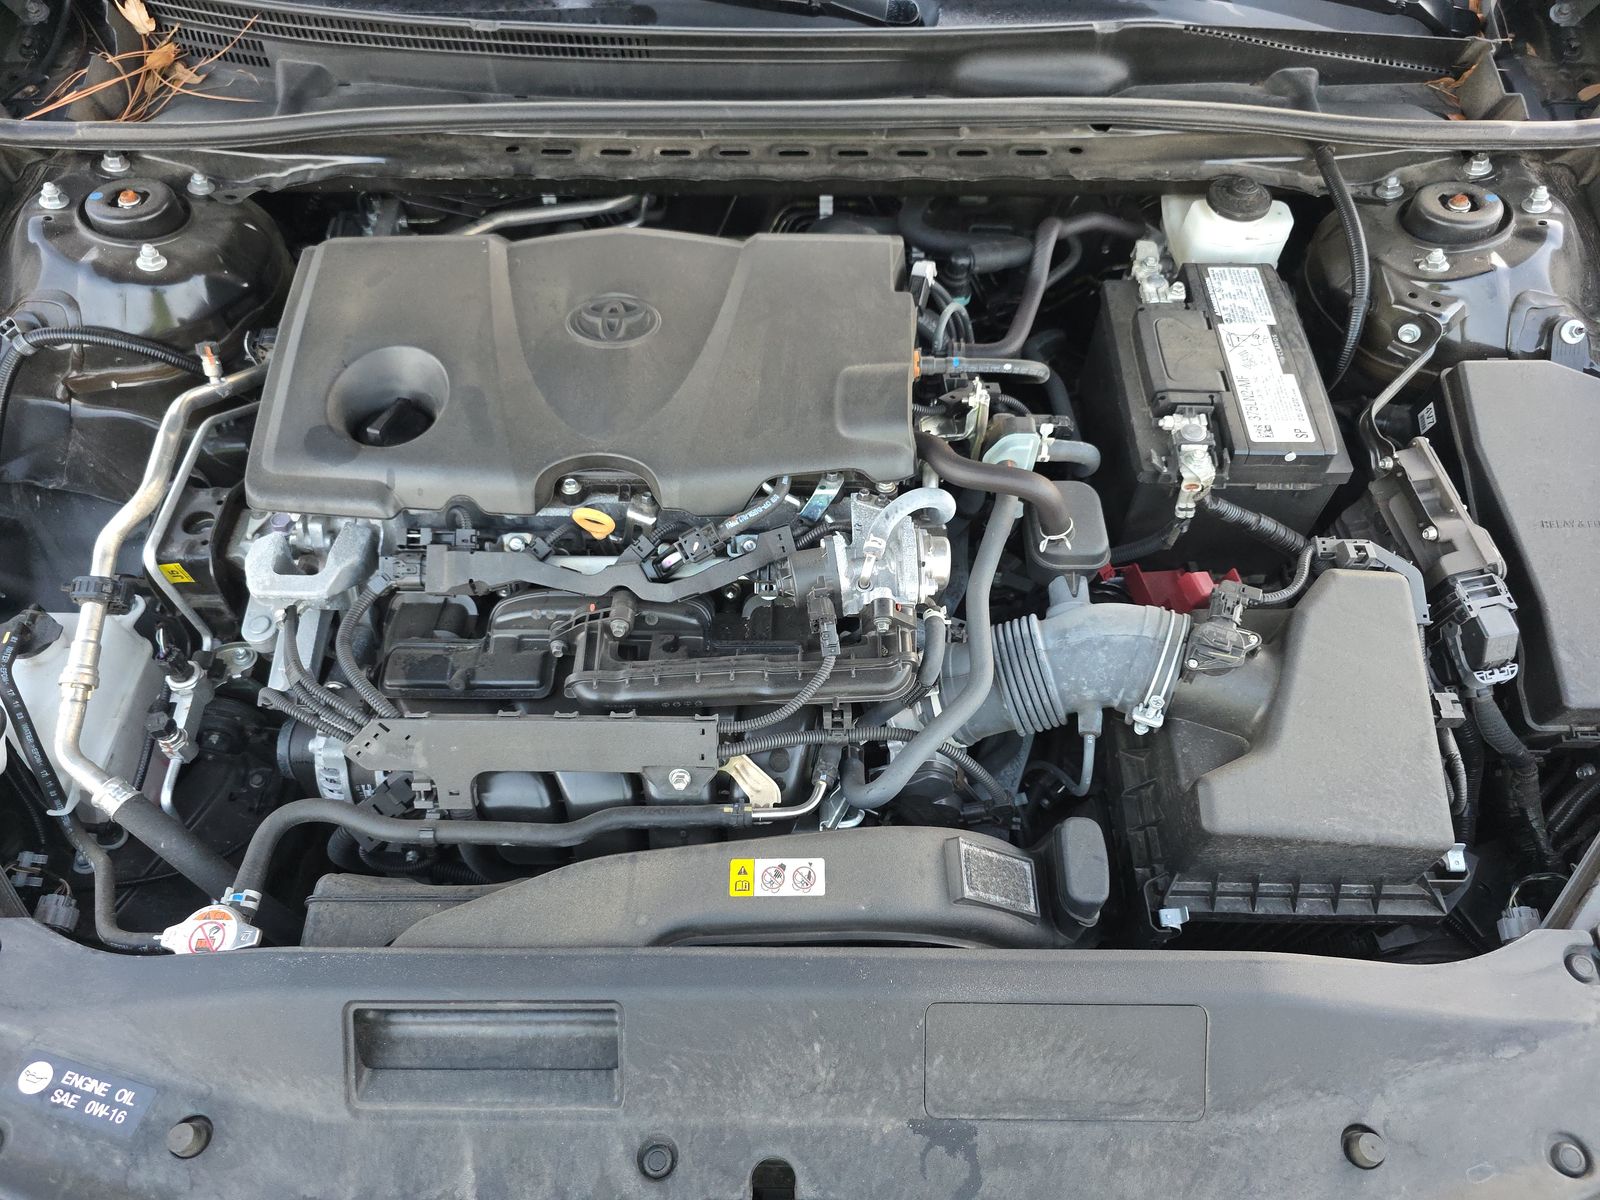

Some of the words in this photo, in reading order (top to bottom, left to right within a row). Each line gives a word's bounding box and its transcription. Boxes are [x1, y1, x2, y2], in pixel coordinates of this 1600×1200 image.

[1293, 428, 1309, 439] SP
[1540, 519, 1575, 529] RELAY
[1577, 519, 1585, 529] &
[60, 1070, 112, 1097] ENGINE
[114, 1088, 136, 1107] OIL
[50, 1089, 82, 1109] SAE
[84, 1099, 128, 1125] 0W-16
